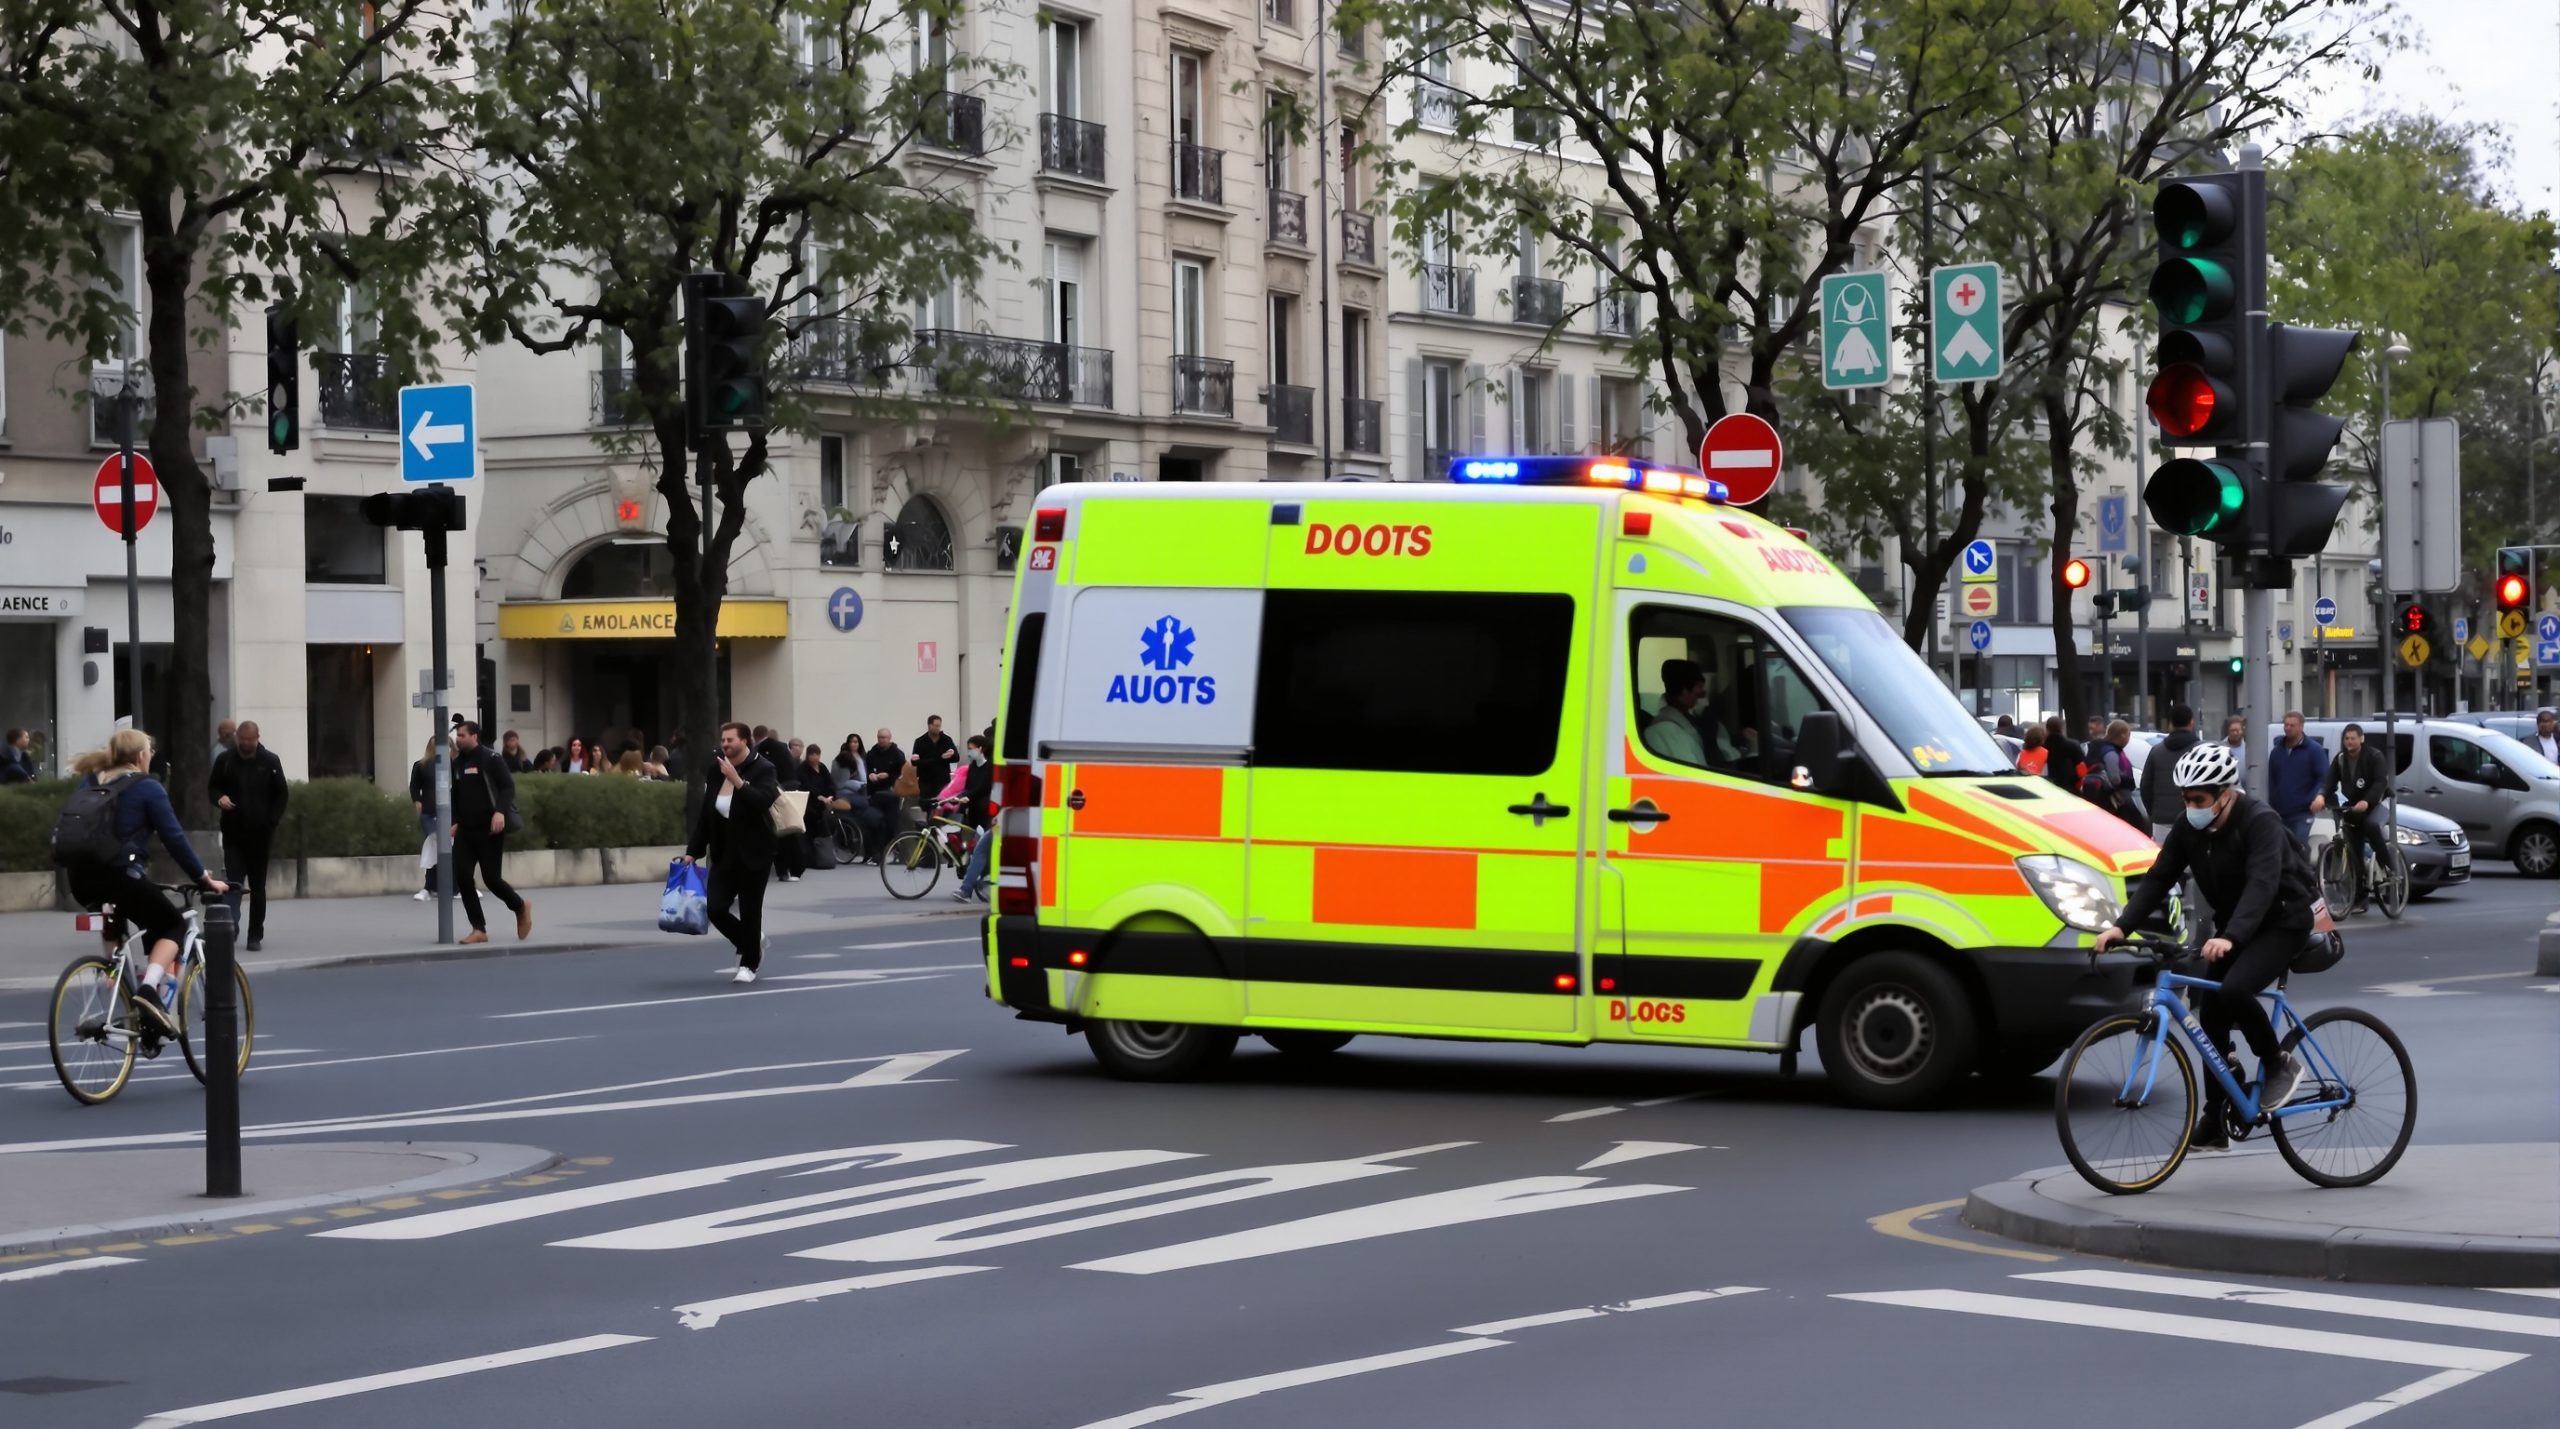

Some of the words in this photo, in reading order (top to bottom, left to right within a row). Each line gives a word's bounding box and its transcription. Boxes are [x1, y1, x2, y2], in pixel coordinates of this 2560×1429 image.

[1305, 523, 1432, 557] DOOTS
[0, 597, 49, 611] AENCE
[1106, 674, 1216, 706] AUOTS
